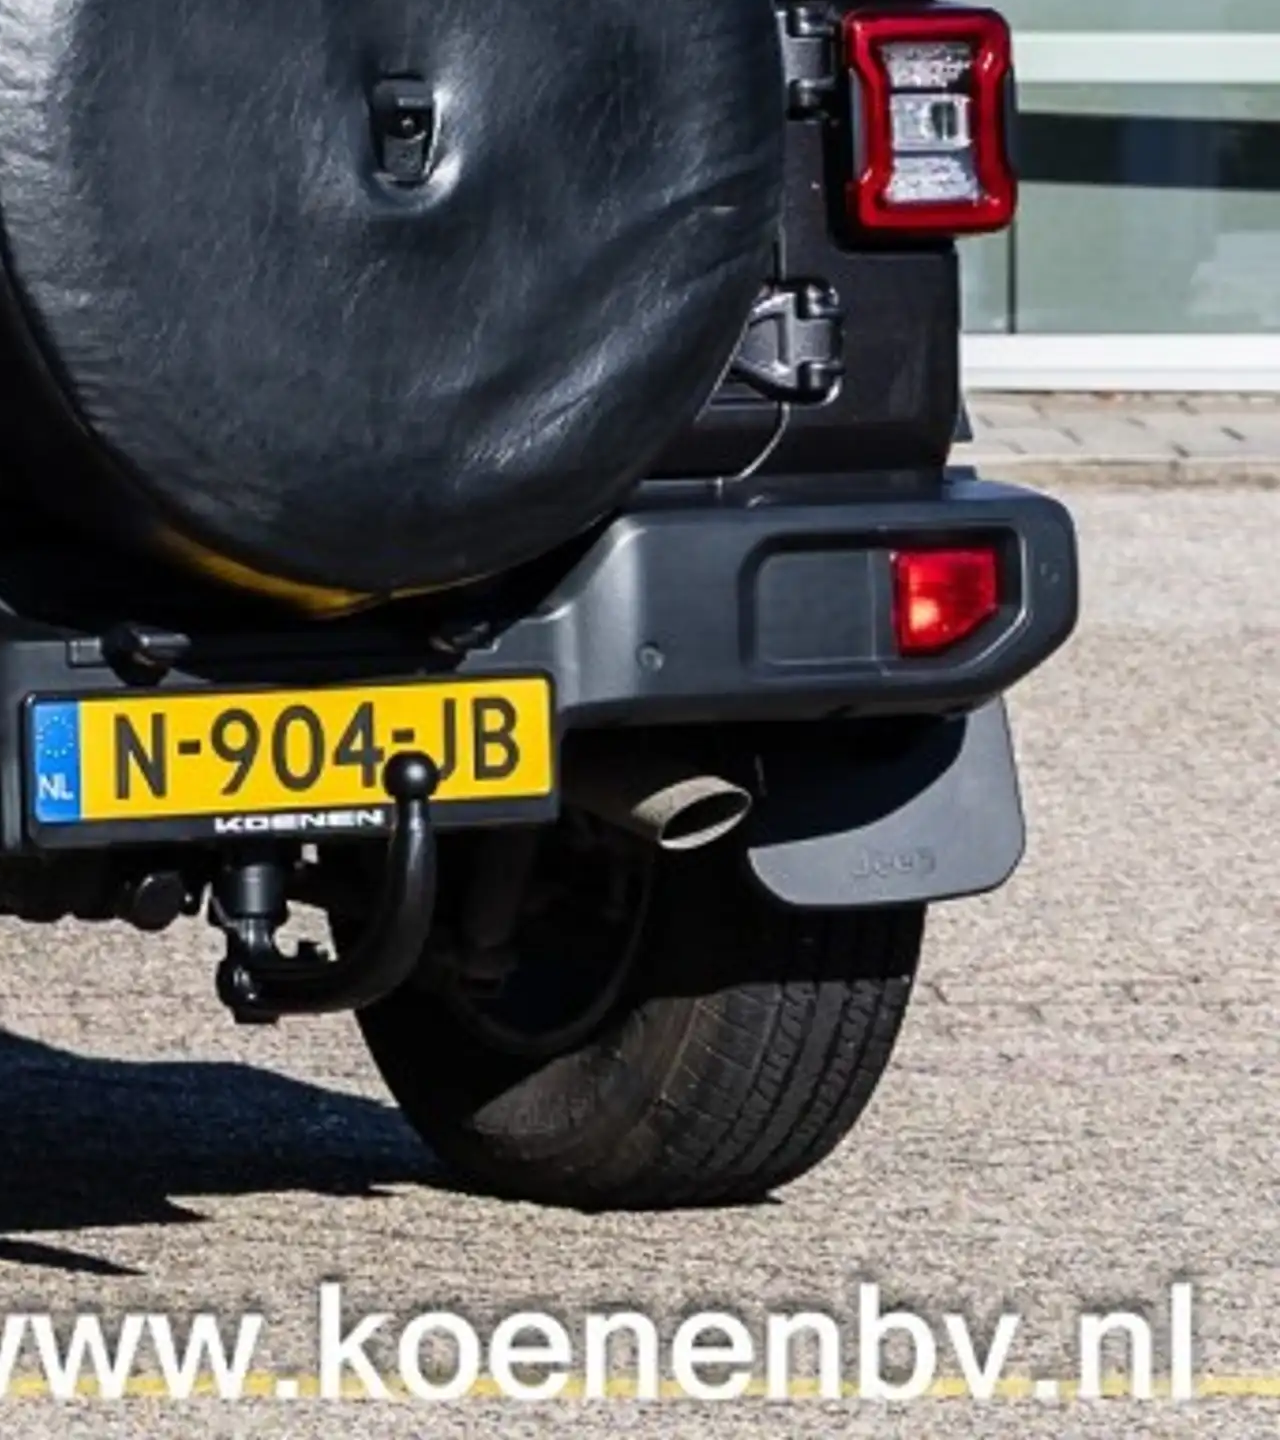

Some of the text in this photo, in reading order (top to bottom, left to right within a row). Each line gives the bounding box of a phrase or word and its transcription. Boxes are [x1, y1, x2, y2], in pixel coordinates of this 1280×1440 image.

[113, 696, 521, 801] N-904-JB
[38, 771, 75, 801] NL
[213, 809, 385, 833] KOENEN
